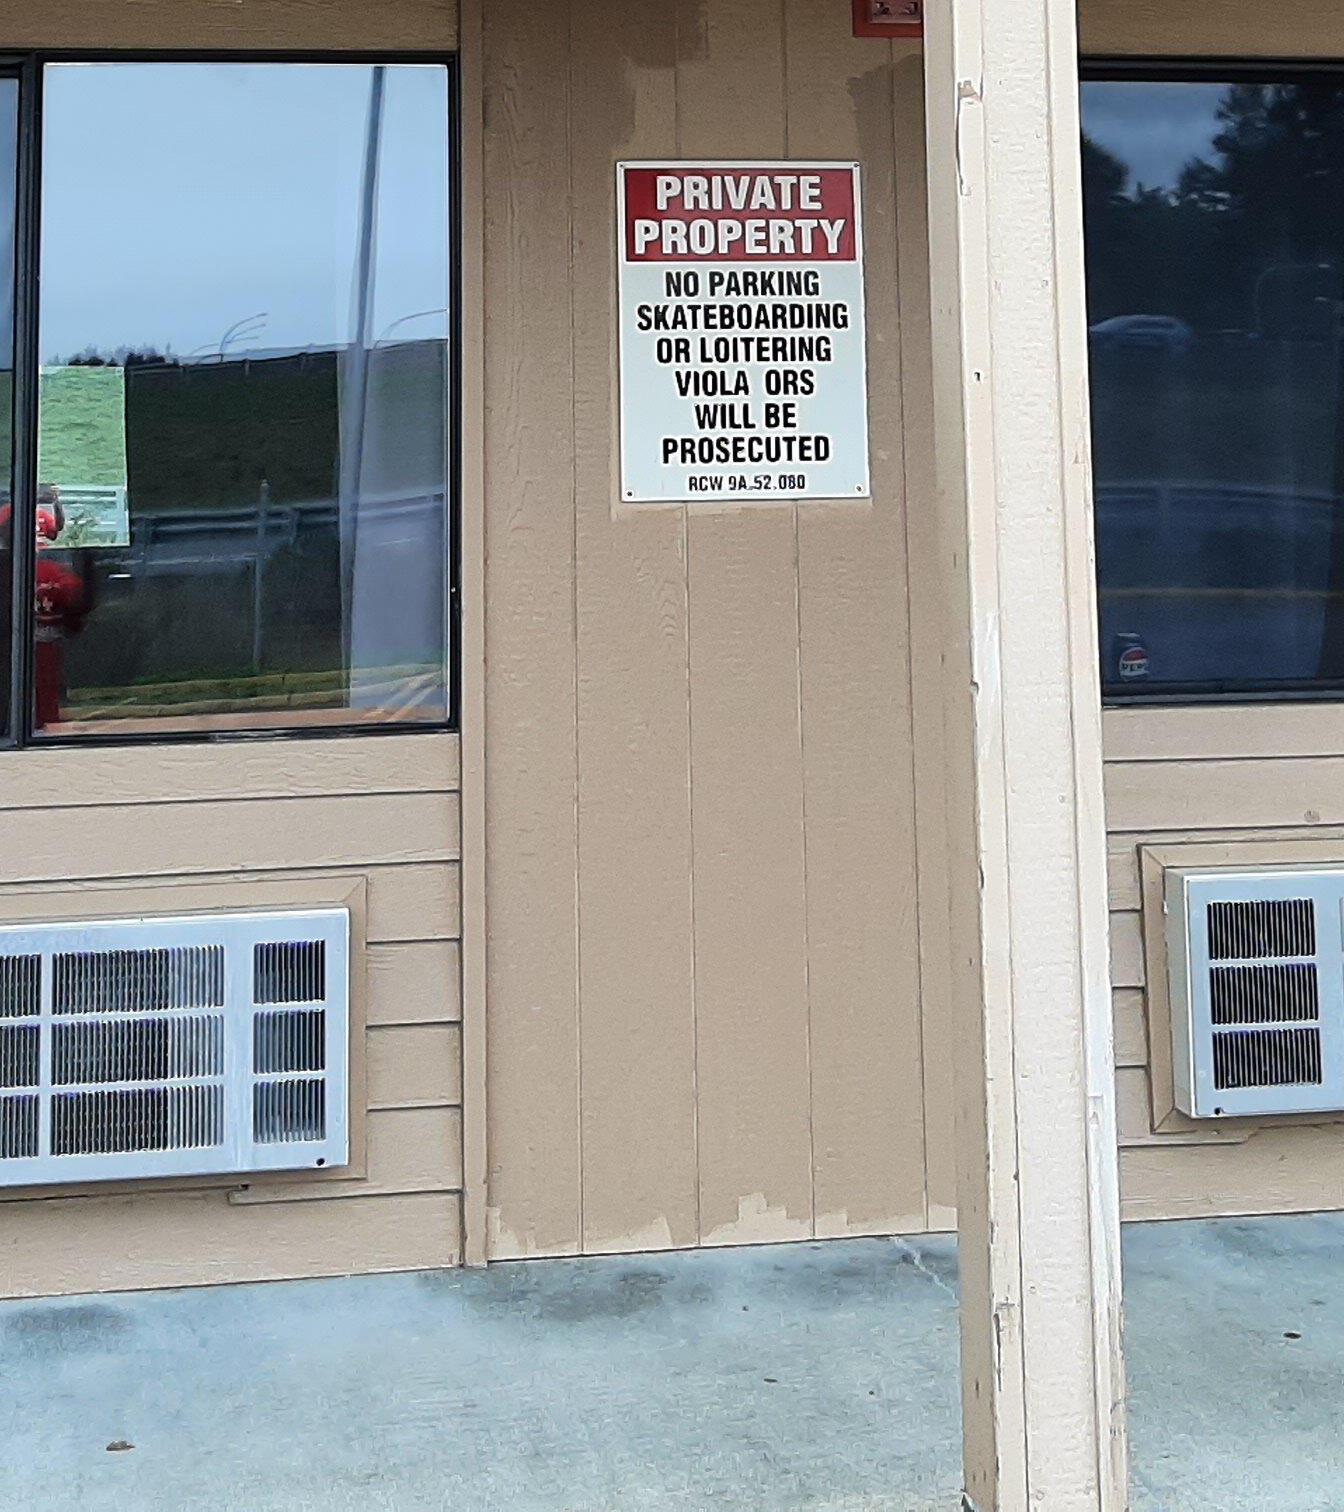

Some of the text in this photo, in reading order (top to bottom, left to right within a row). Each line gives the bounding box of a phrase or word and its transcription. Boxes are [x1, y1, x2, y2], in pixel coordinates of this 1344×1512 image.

[656, 175, 823, 211] PRIVATE
[634, 218, 846, 255] PROPERTY
[665, 270, 820, 297] NO PARKING
[637, 303, 849, 331] SKATEBOARDING
[656, 336, 832, 364] OR LOITERING
[675, 369, 815, 397] VIOLAORS
[694, 402, 797, 430] WILL BE
[662, 435, 830, 464] PROSECUTED
[688, 475, 723, 492] RCW
